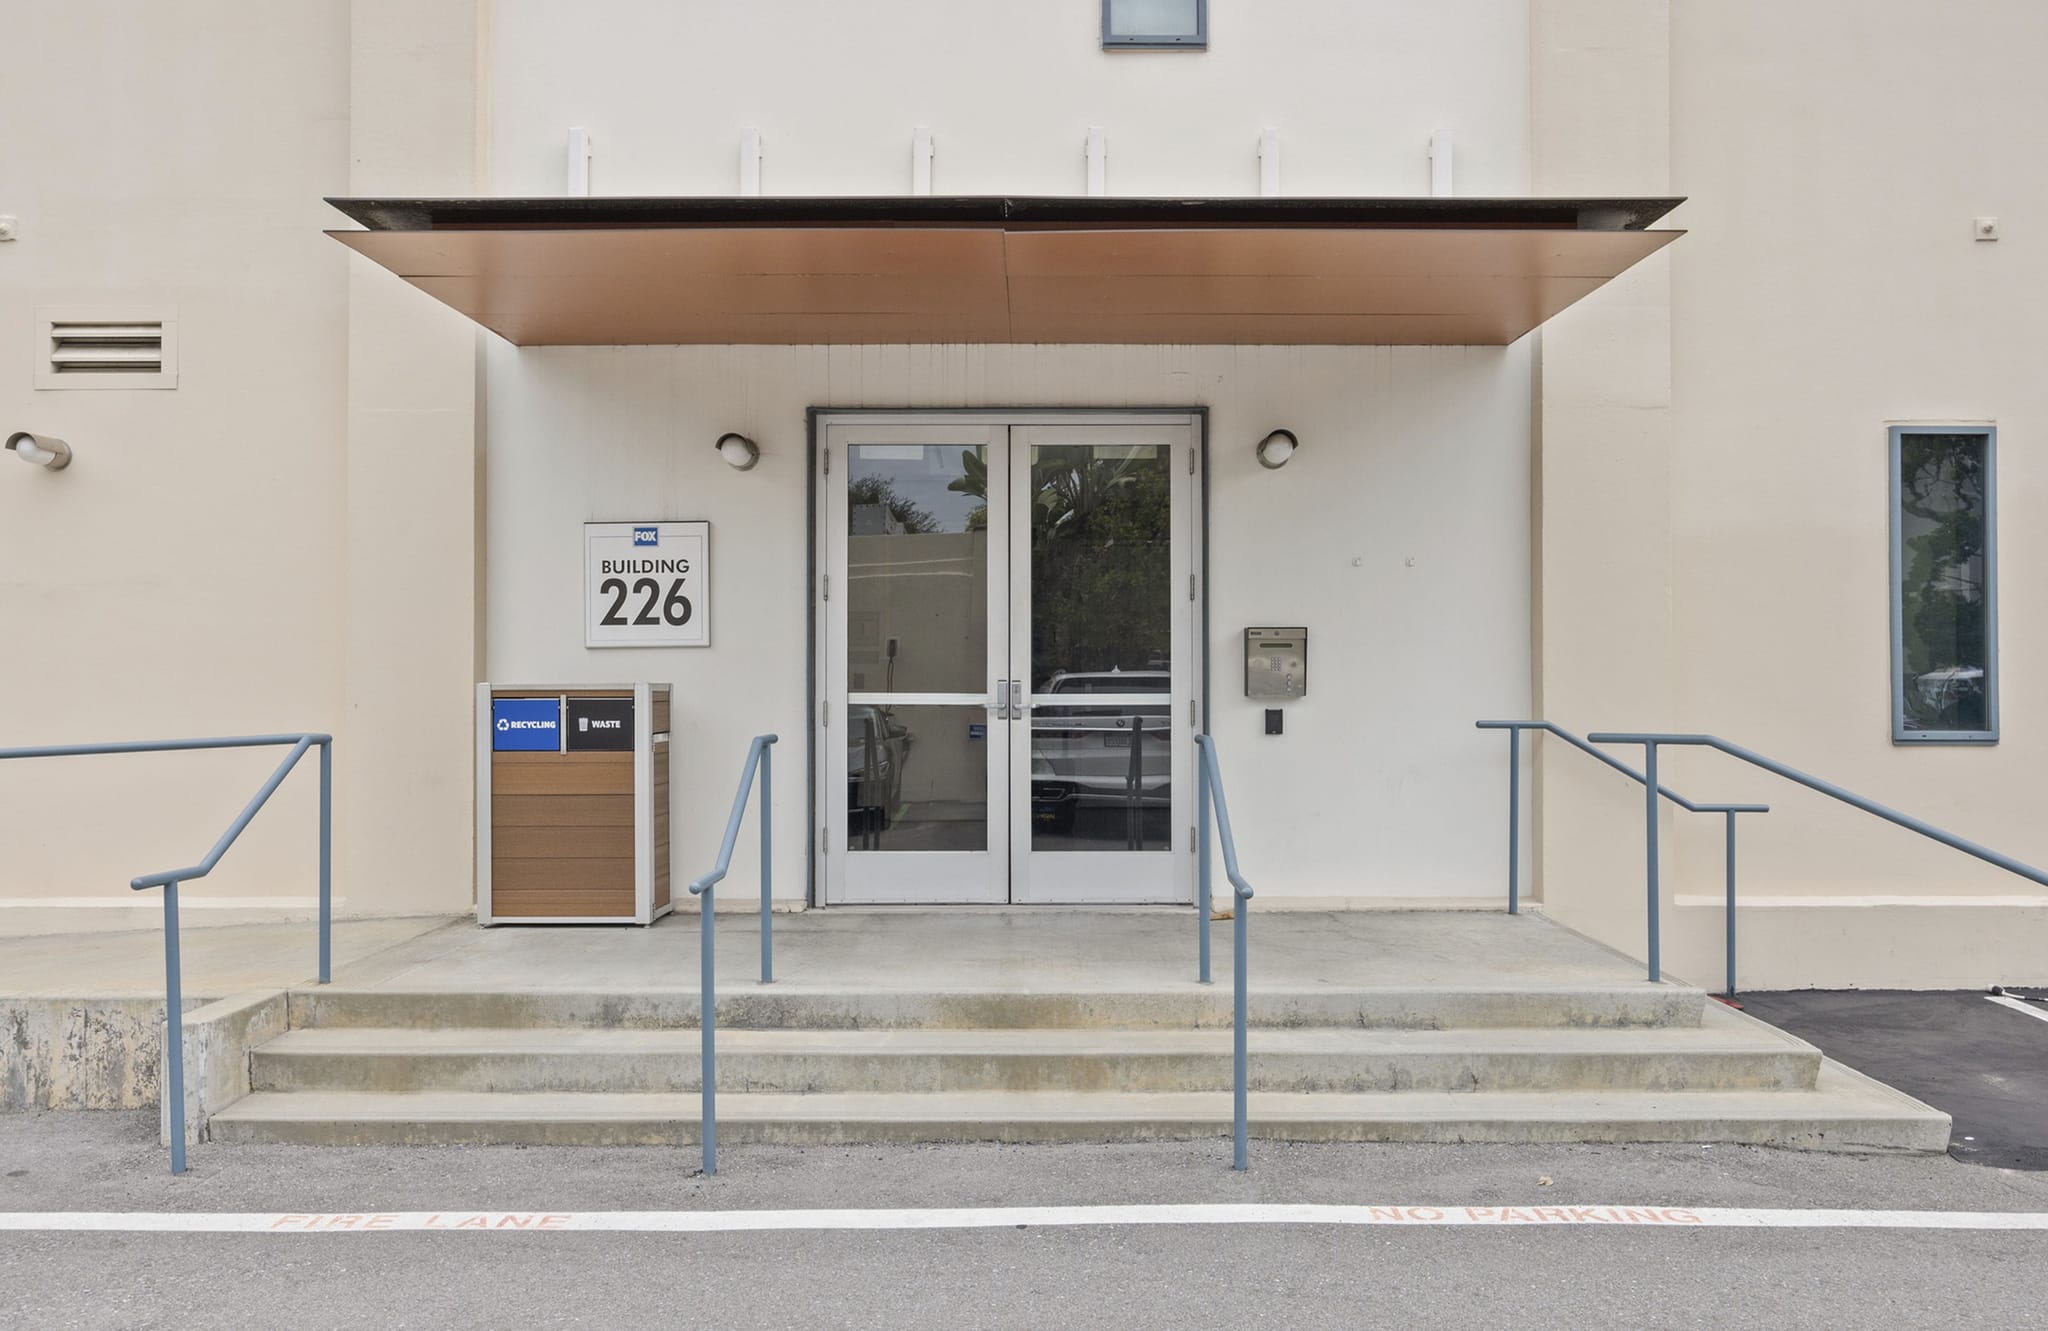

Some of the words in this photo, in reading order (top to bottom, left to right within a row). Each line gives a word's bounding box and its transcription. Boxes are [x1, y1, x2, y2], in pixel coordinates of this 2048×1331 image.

[635, 531, 656, 542] FOX
[602, 559, 690, 574] BUILDING
[599, 577, 692, 626] 226
[510, 720, 556, 729] RECYCLING
[591, 719, 621, 728] WASTE
[271, 1214, 399, 1229] FIRE
[423, 1214, 572, 1229] LANE
[1367, 1206, 1446, 1221] NO
[1464, 1206, 1704, 1223] PARKING
